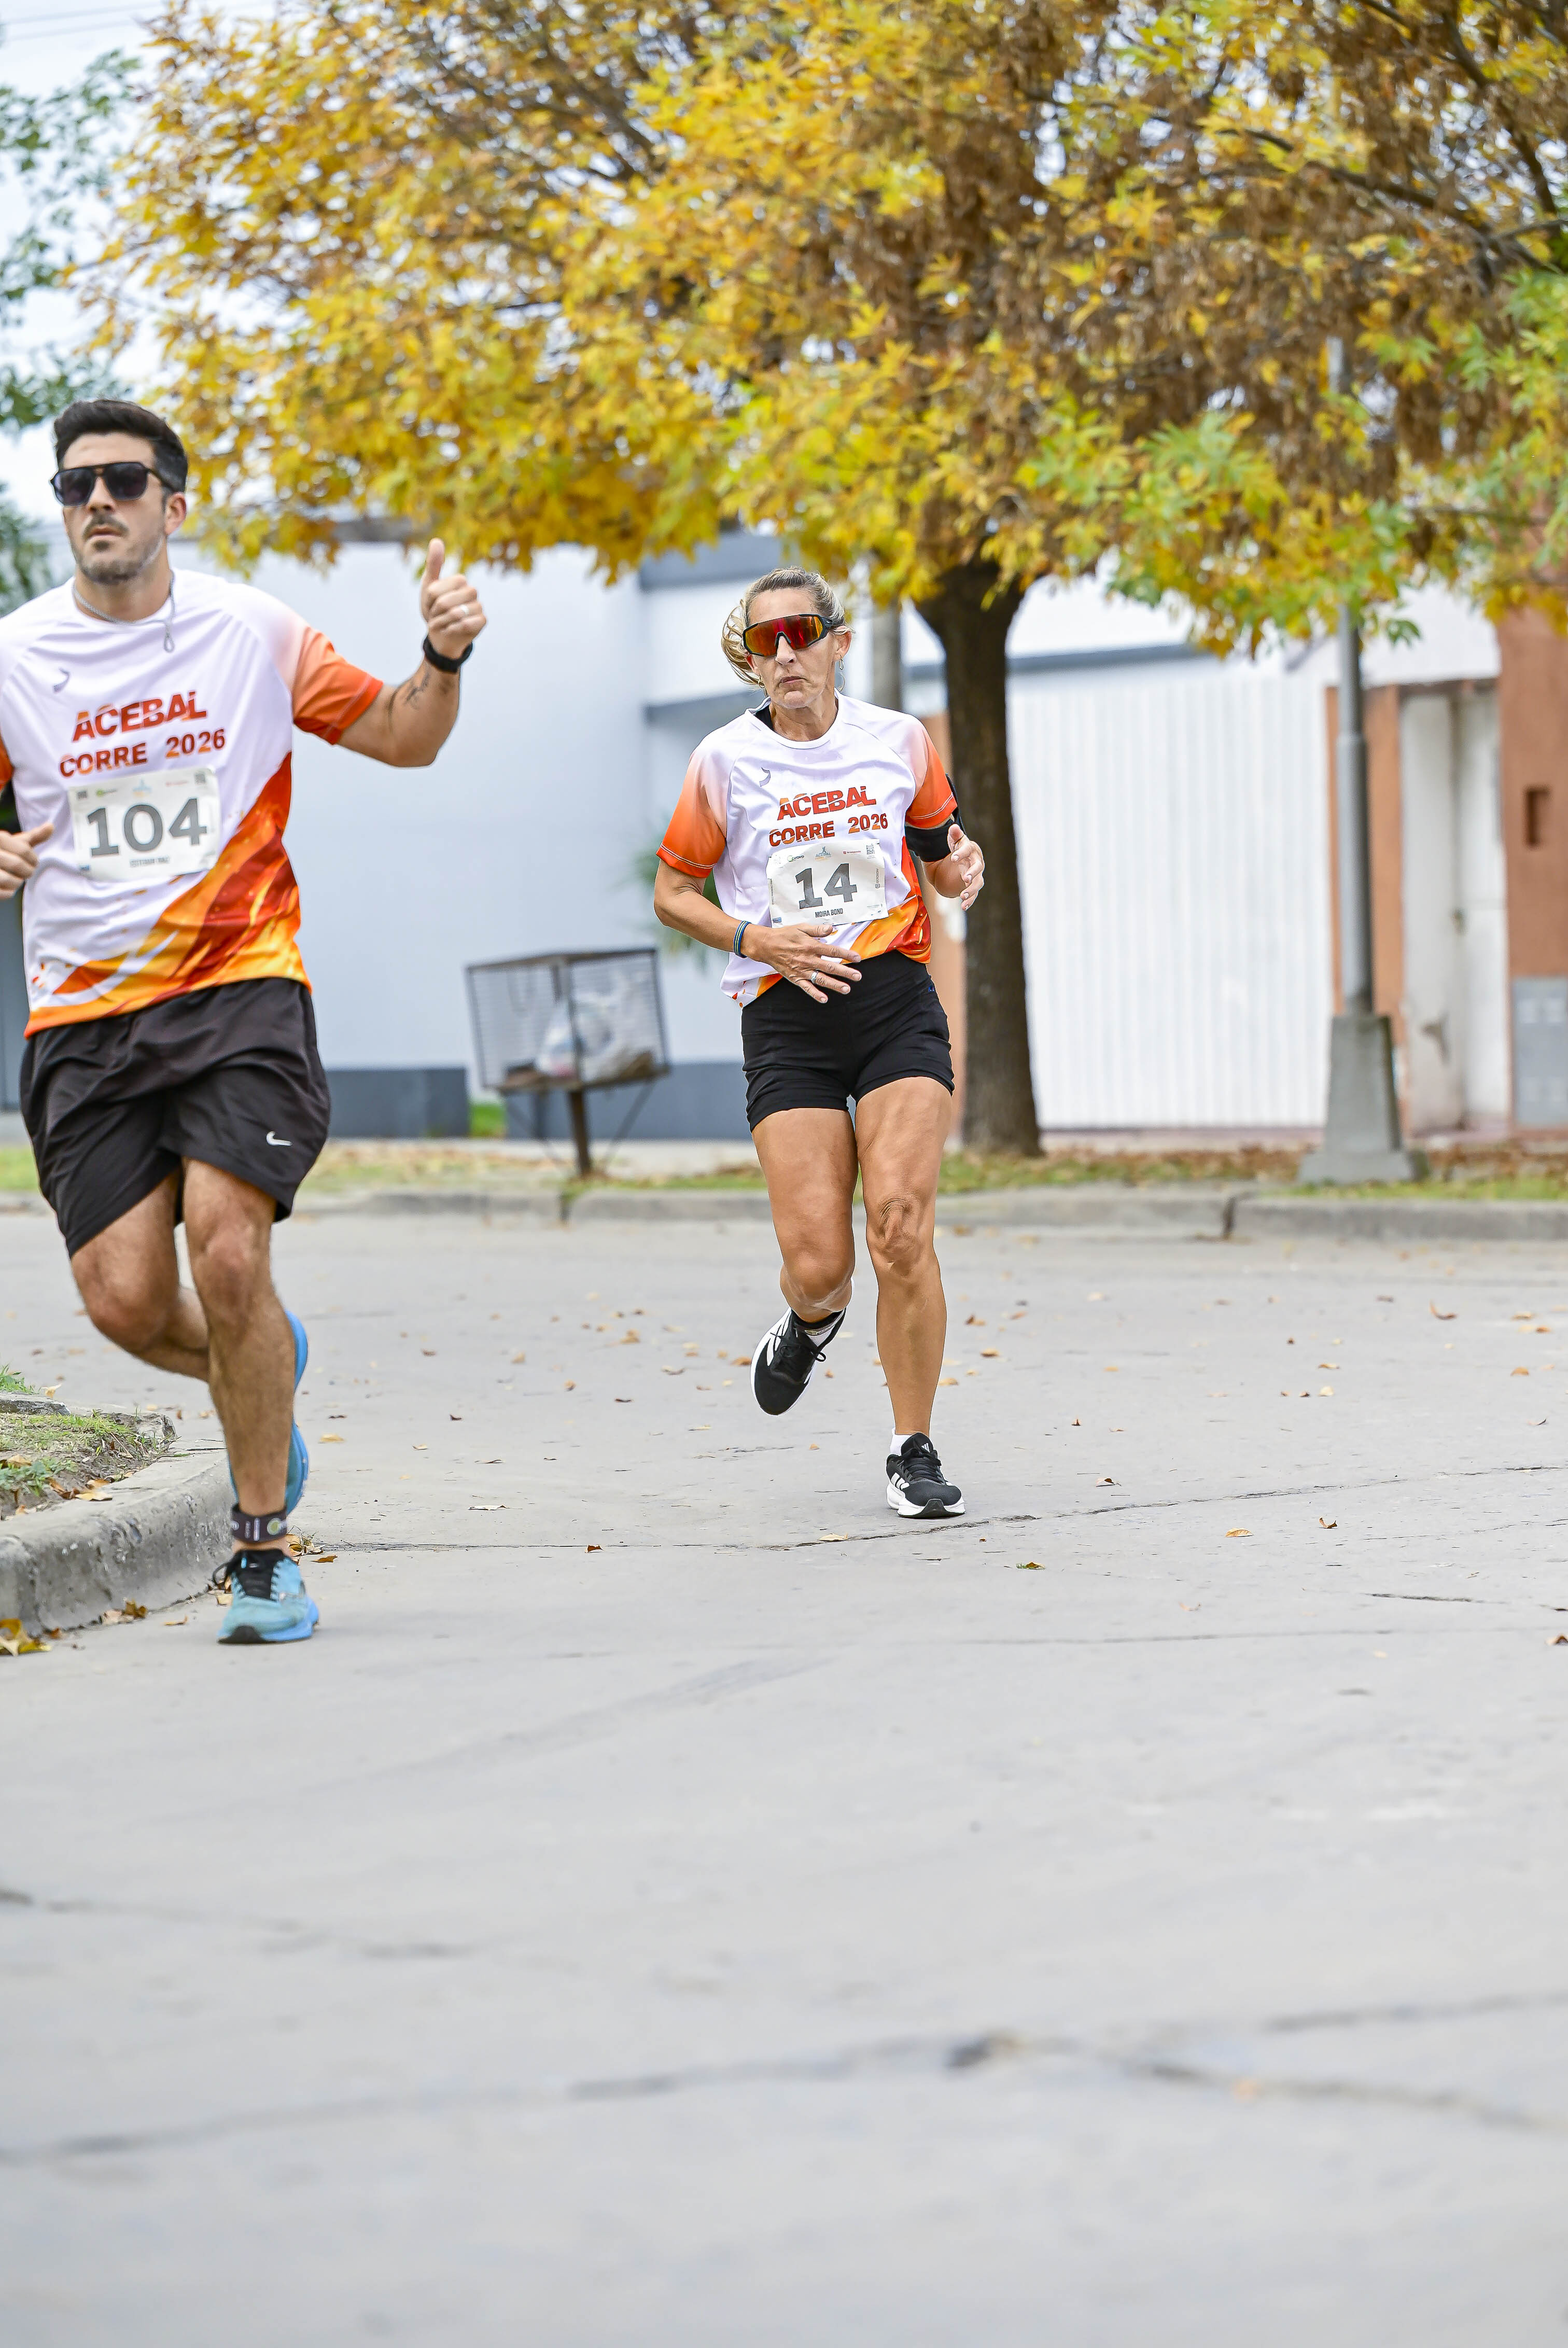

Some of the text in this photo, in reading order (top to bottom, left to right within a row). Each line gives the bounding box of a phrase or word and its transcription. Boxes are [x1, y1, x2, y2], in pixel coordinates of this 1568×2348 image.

[72, 691, 206, 742] ACEBAL
[60, 728, 225, 777] CORRE 2026
[777, 786, 876, 820] ACEBAL
[87, 798, 207, 857] 104
[769, 813, 888, 847] CORRE 2026
[795, 863, 857, 909] 14
